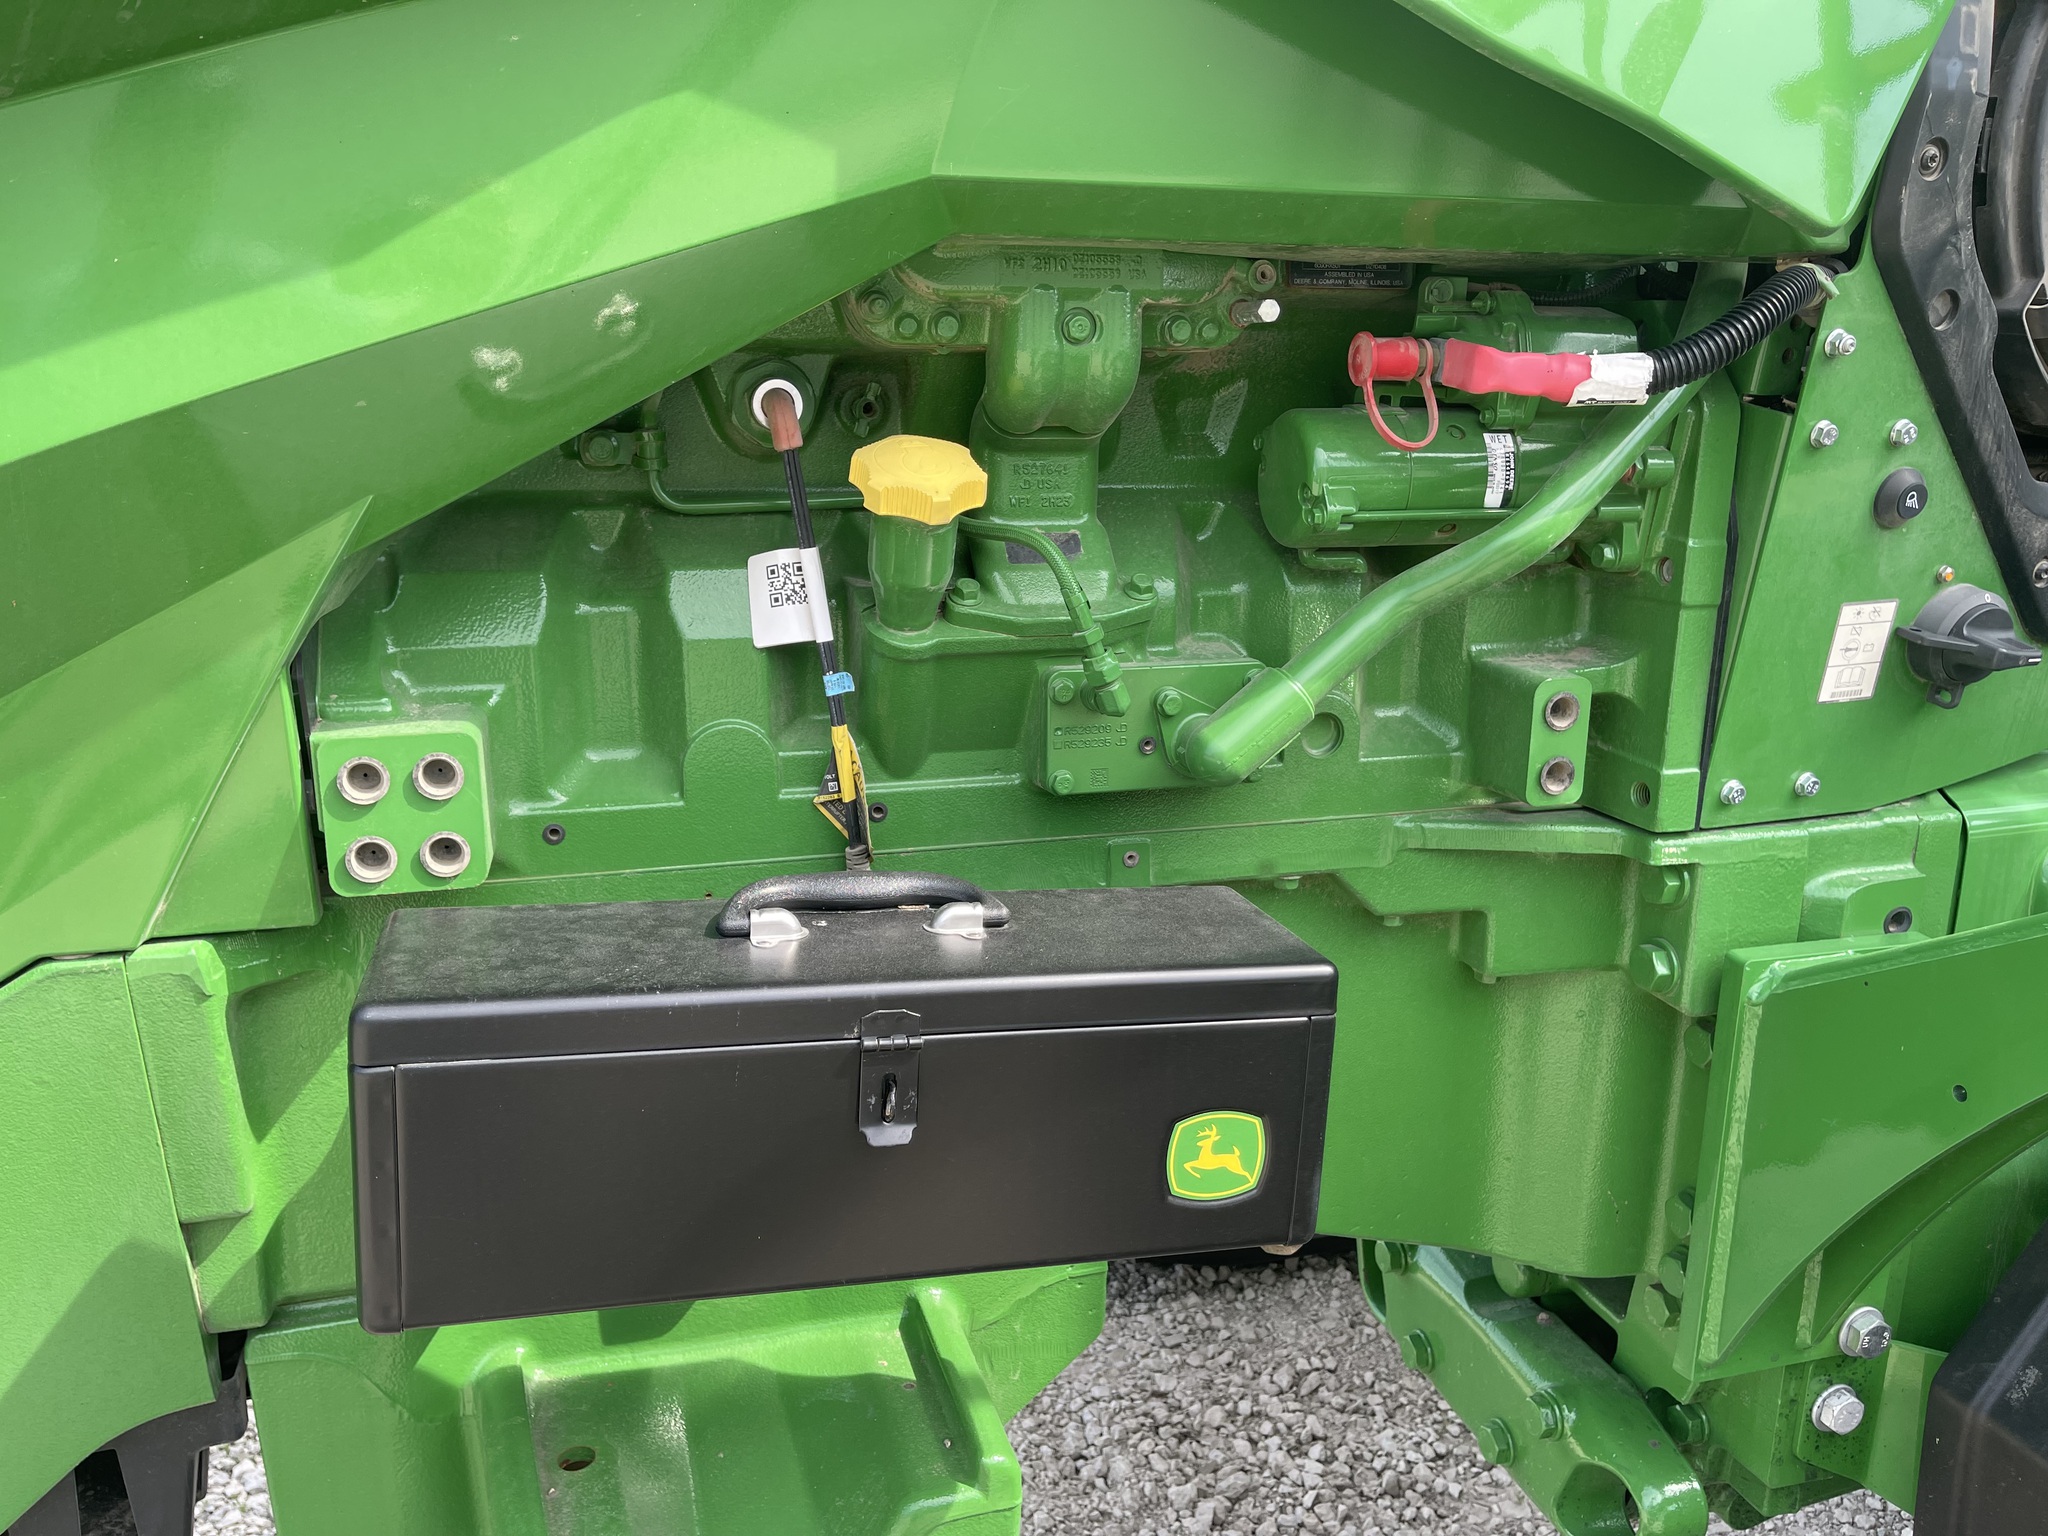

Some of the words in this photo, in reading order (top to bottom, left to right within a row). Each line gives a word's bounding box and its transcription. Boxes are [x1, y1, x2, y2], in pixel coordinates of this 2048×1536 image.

[1128, 268, 1148, 280] USA
[1489, 434, 1508, 443] WET
[1037, 478, 1061, 490] USA
[1064, 723, 1111, 736] R529209
